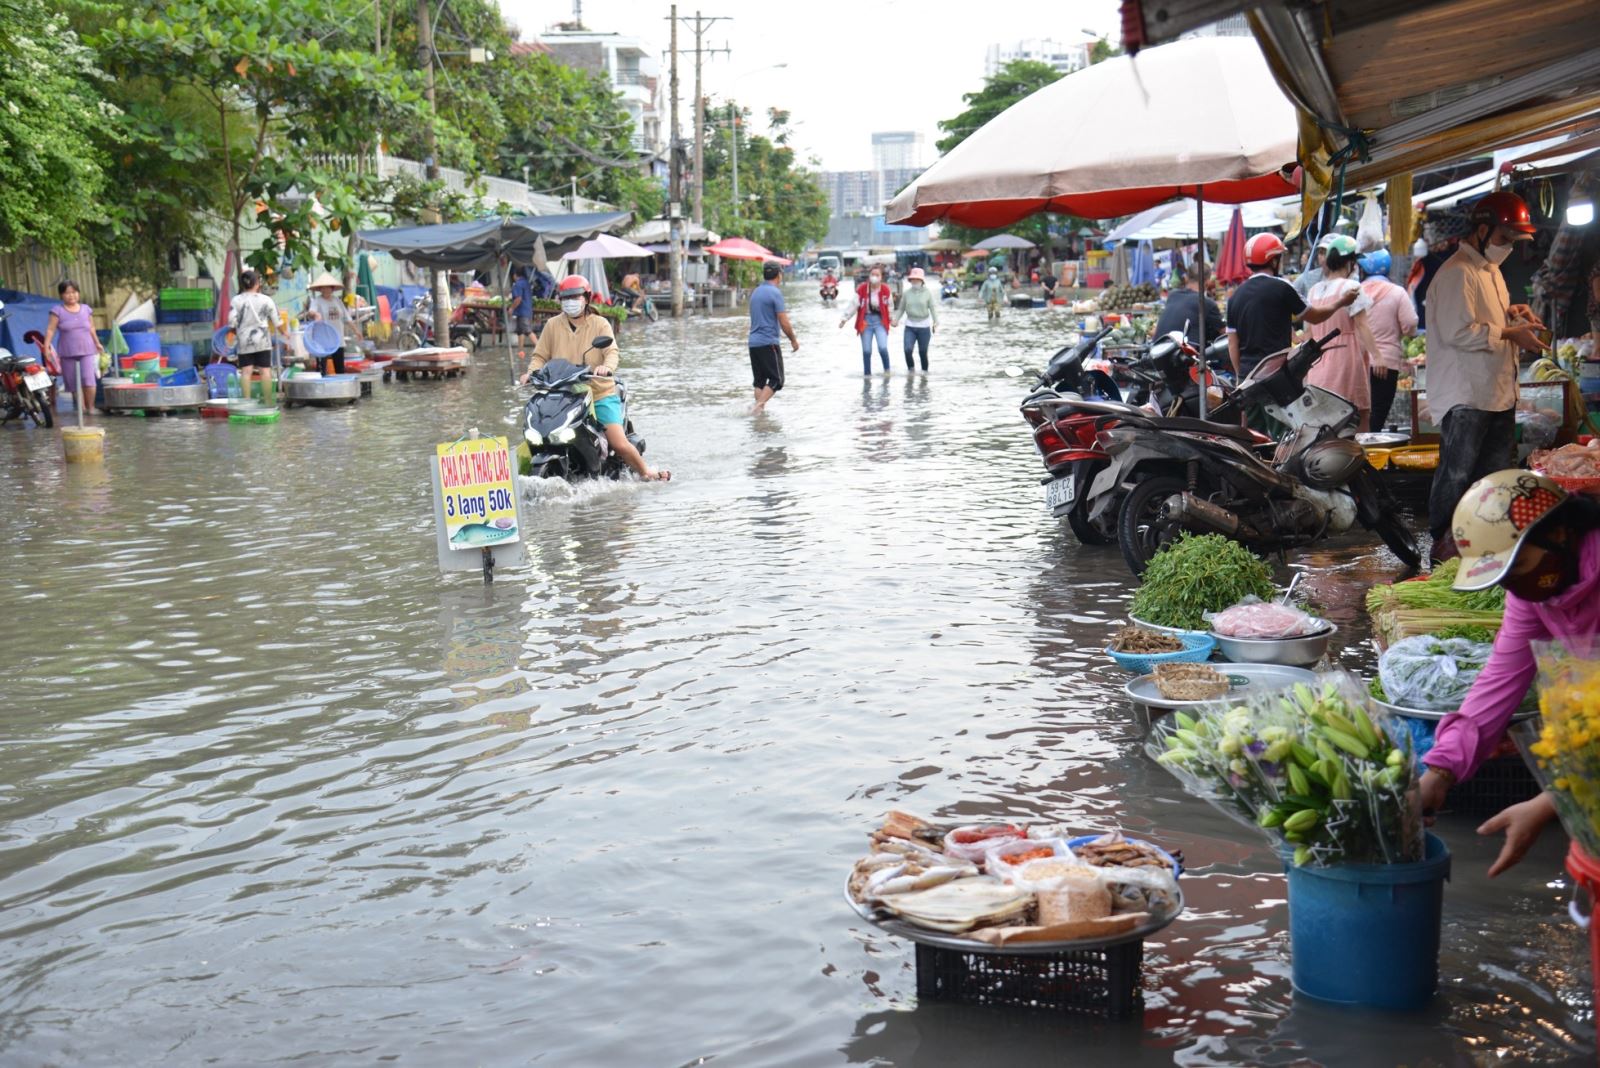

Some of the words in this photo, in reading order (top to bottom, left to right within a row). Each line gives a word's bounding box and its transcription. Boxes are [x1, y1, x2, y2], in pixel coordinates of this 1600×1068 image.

[459, 446, 471, 486] CÁ
[471, 443, 493, 484] THÁC
[446, 495, 455, 516] 3
[458, 494, 486, 519] lạng
[488, 488, 513, 511] 50k
